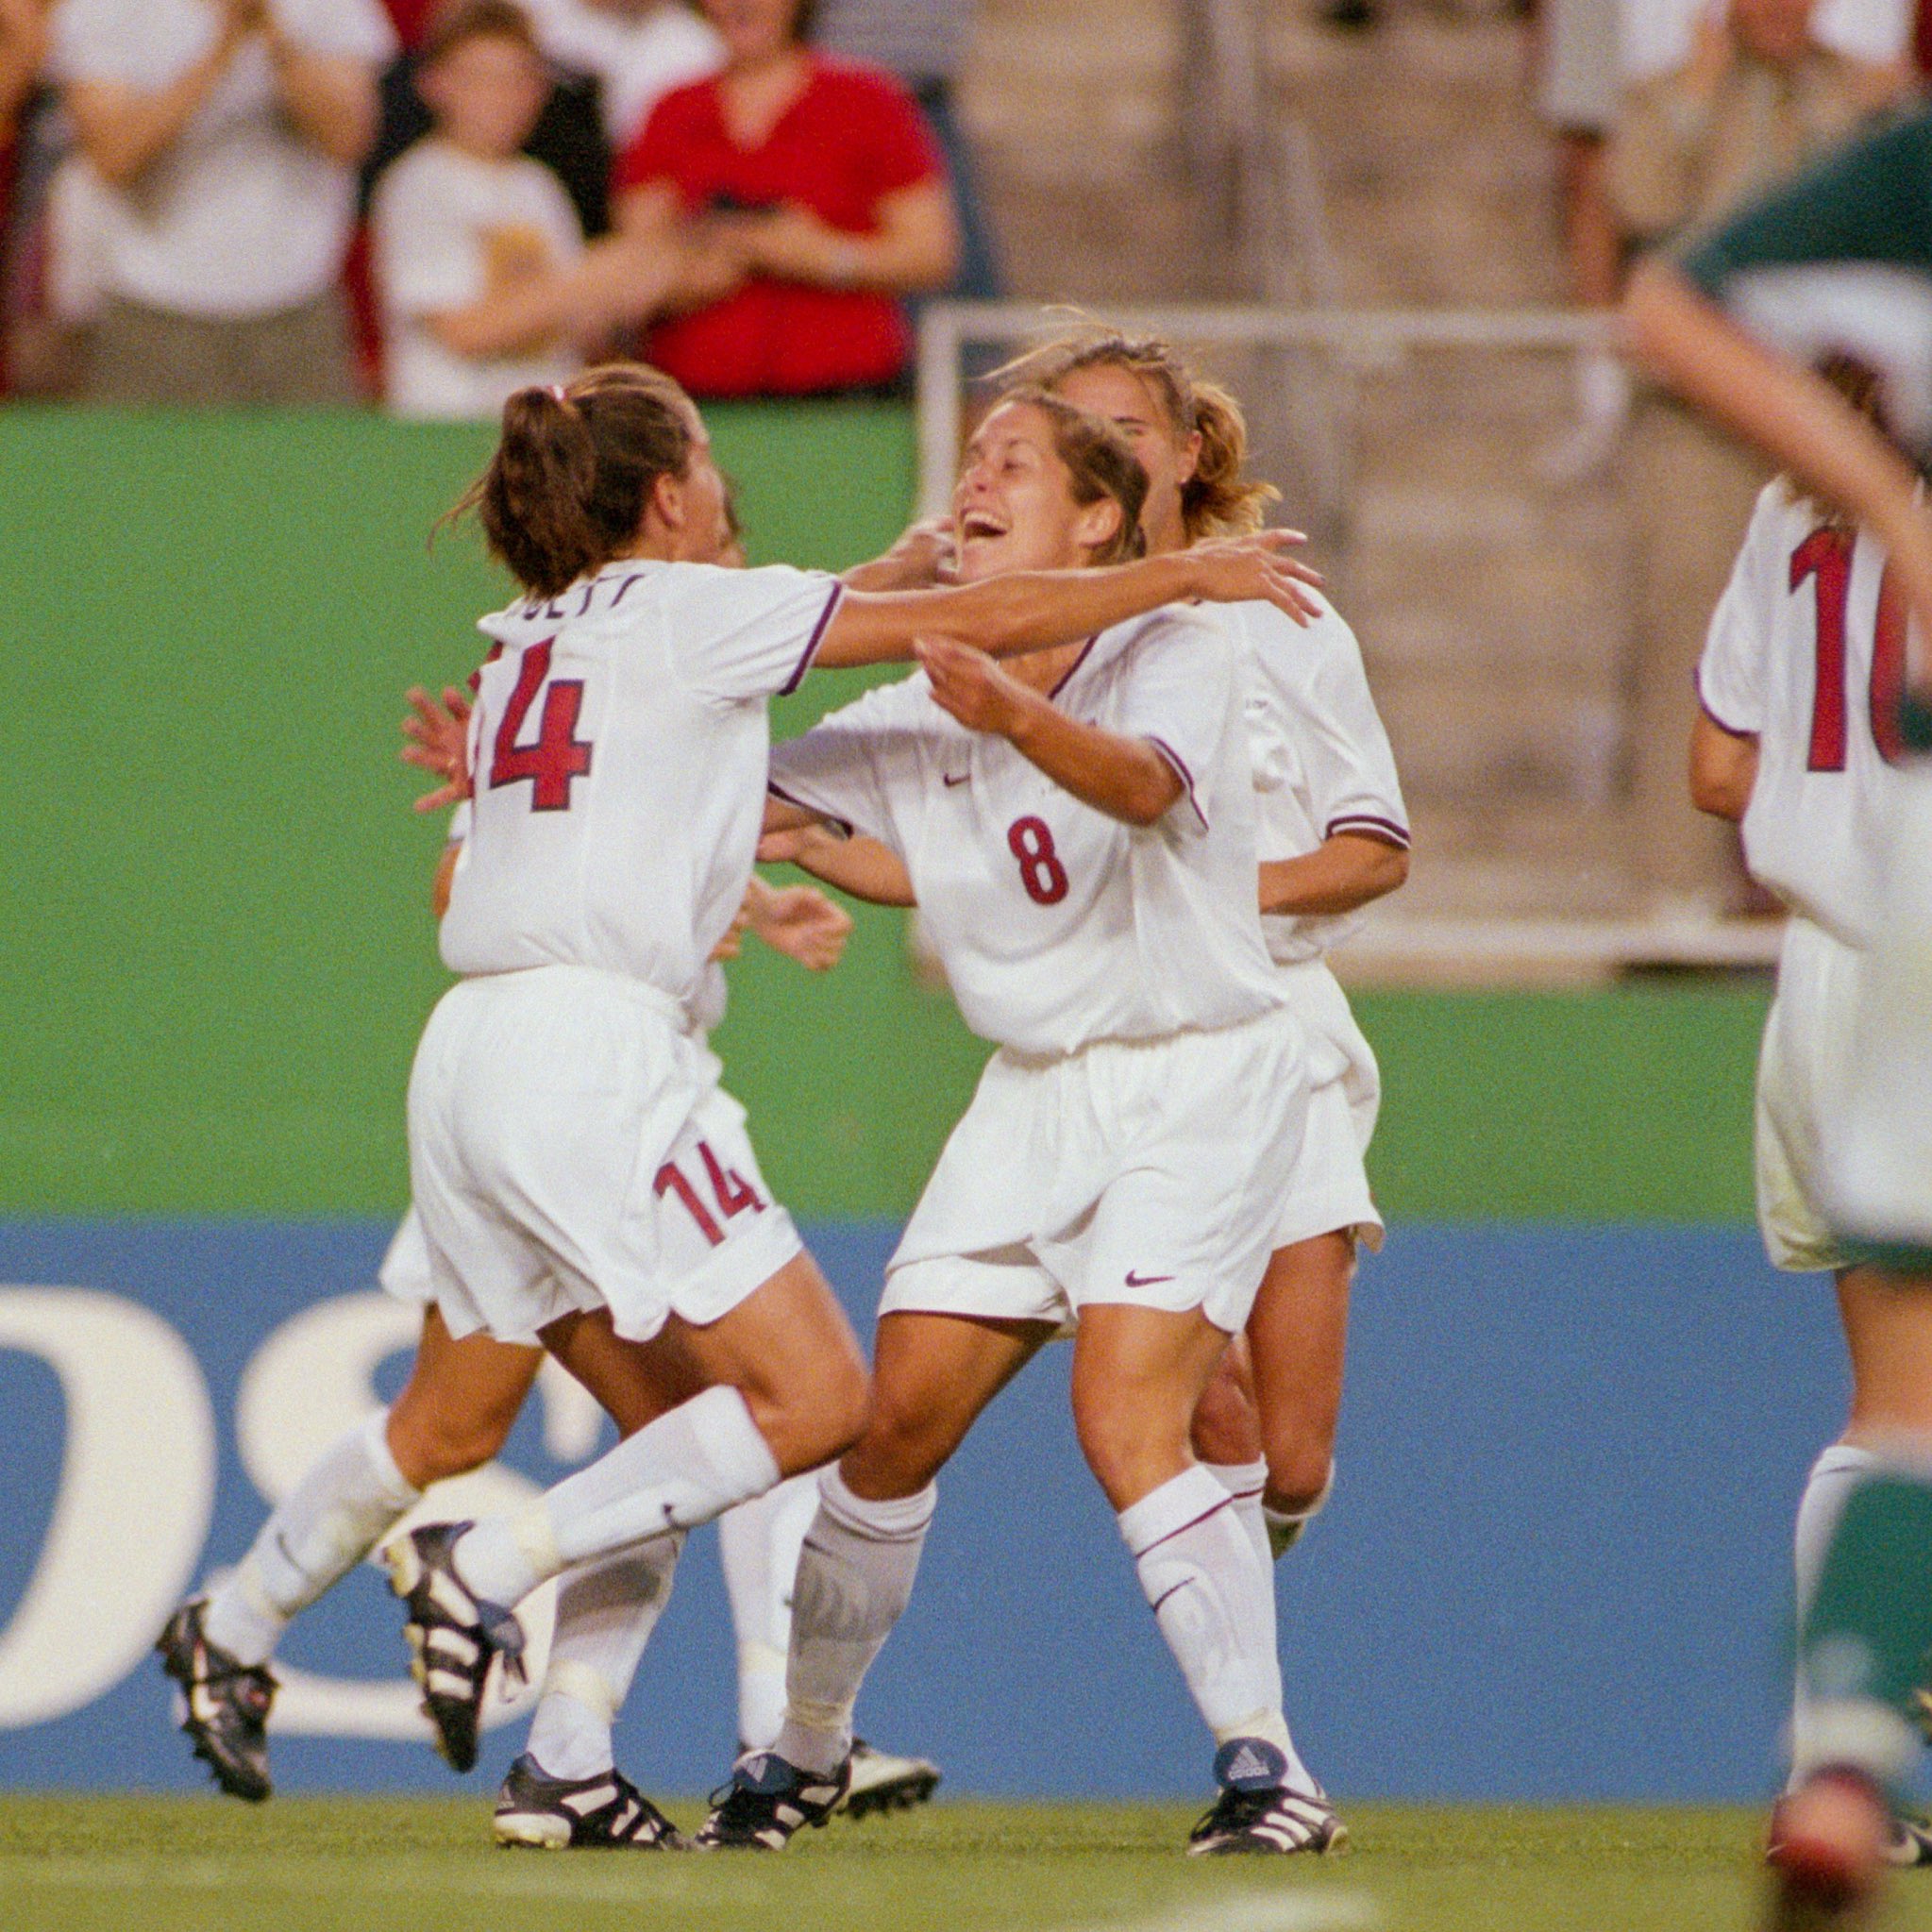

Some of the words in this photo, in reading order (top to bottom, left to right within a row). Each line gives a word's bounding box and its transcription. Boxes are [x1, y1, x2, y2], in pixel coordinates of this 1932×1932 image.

[468, 634, 594, 813] 4
[1008, 815, 1069, 907] 8
[652, 1140, 767, 1249] 14
